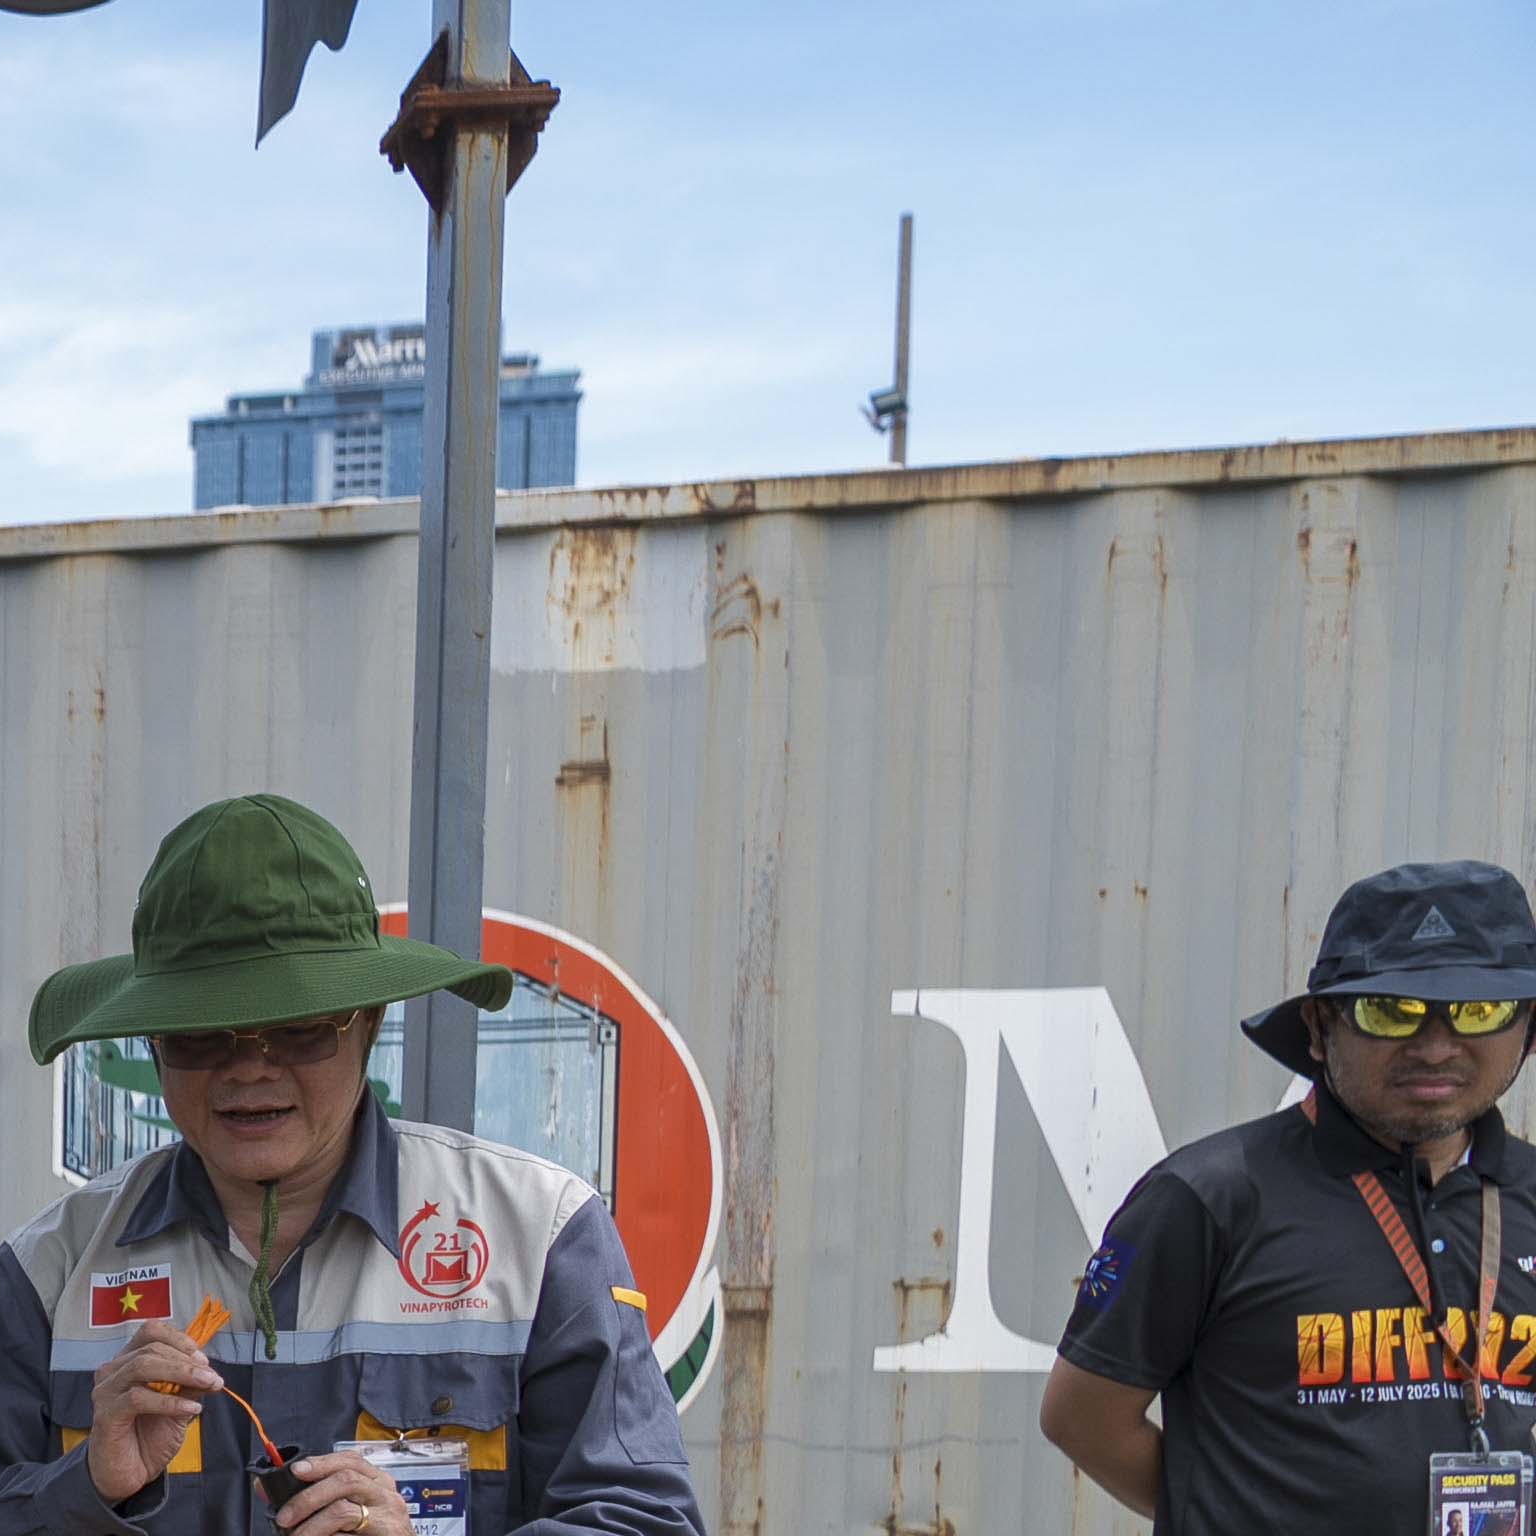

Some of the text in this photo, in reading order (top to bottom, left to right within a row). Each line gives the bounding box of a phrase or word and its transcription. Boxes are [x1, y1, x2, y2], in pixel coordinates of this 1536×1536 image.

[344, 336, 425, 370] Marri
[434, 1232, 461, 1251] 21
[105, 1266, 160, 1287] VIETNAM
[399, 1298, 489, 1313] VINAPYROTECH
[1318, 1388, 1347, 1404] MAY
[1361, 1386, 1374, 1402] 12
[1377, 1386, 1403, 1402] JULY
[1407, 1383, 1440, 1400] 2025
[1442, 1473, 1516, 1487] SECURITY PASS
[431, 1524, 439, 1536] 2
